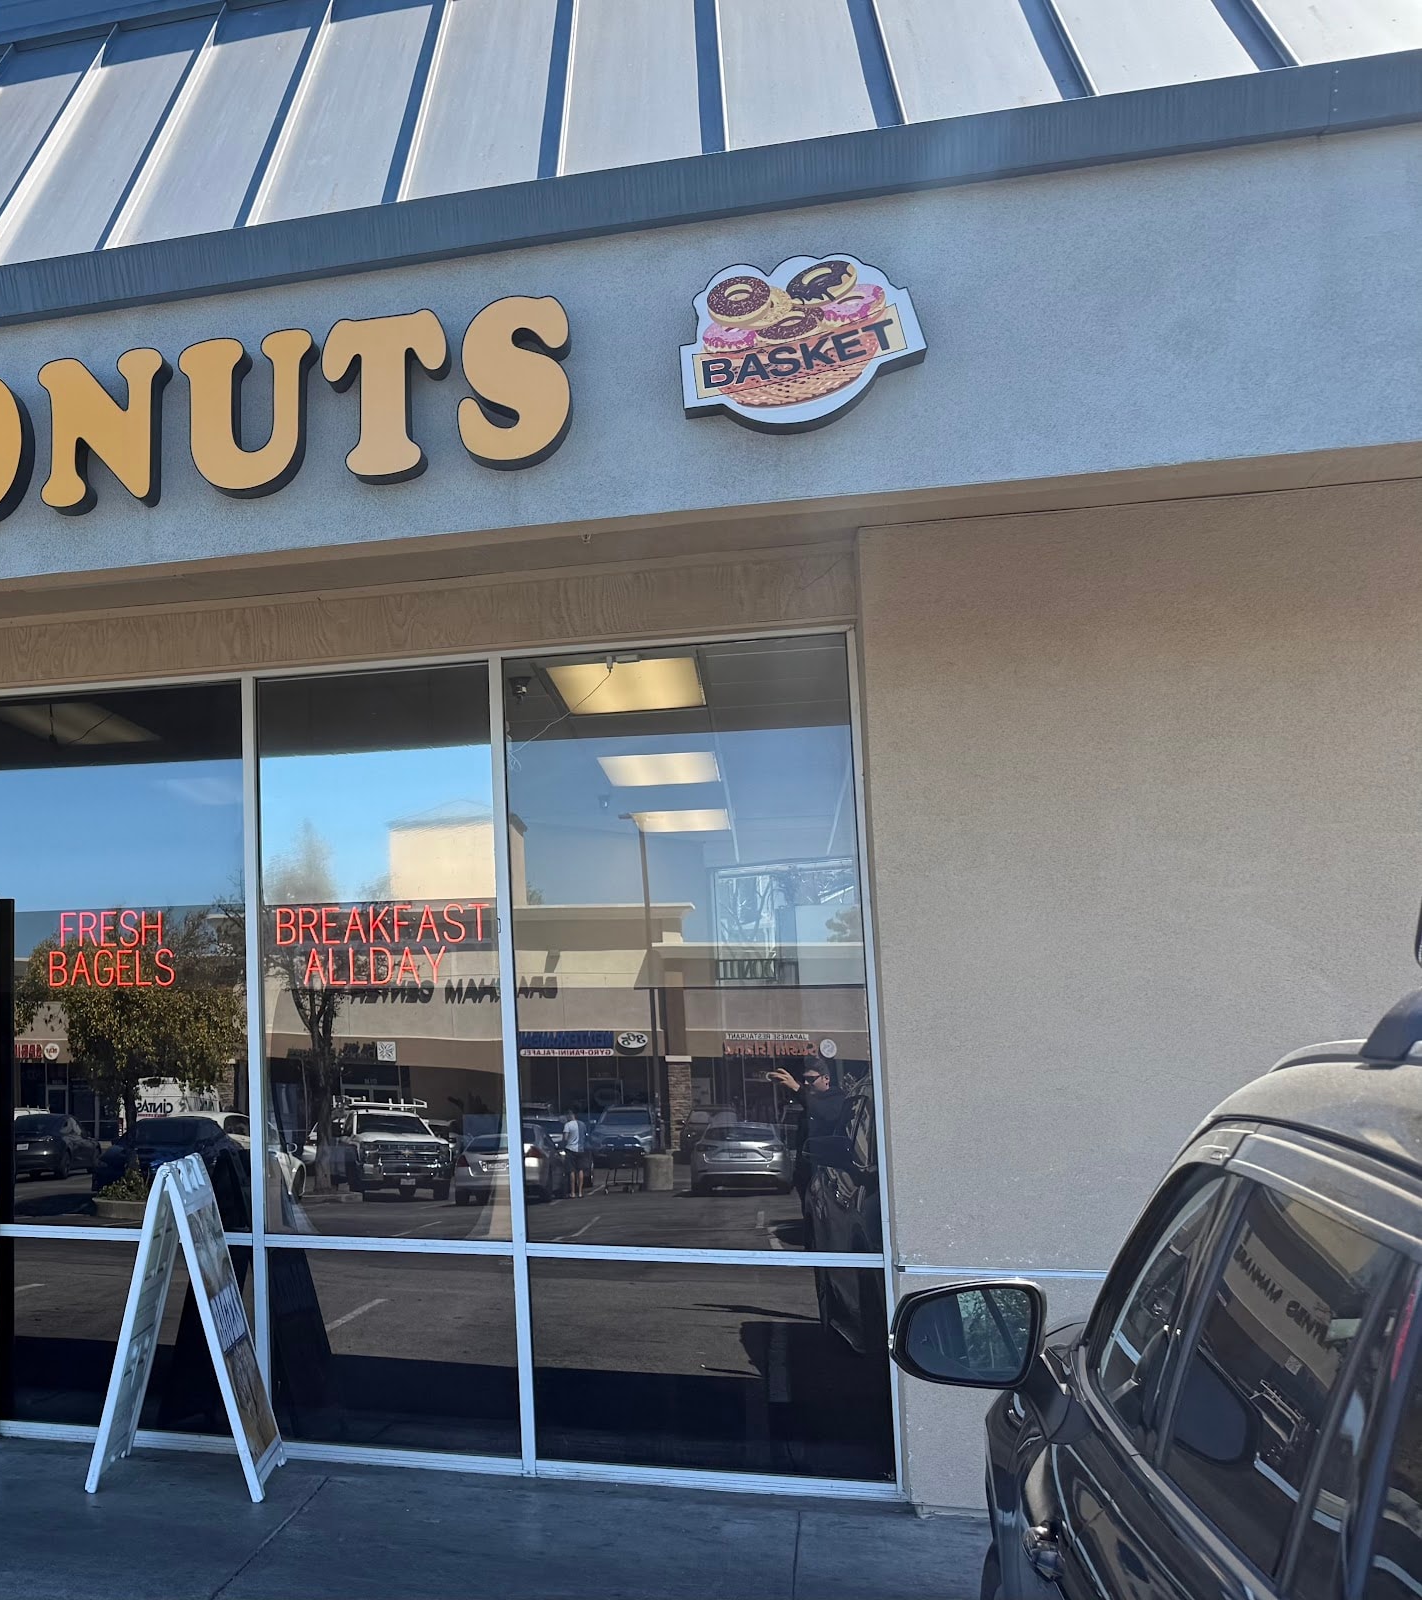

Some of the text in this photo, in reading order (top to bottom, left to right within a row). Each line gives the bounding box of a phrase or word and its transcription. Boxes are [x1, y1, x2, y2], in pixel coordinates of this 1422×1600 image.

[701, 318, 894, 390] BASKET
[59, 910, 163, 948] FRESH
[276, 903, 490, 945] BREAKFAST
[49, 948, 176, 988] BAGELS
[304, 945, 446, 987] ALLDAY
